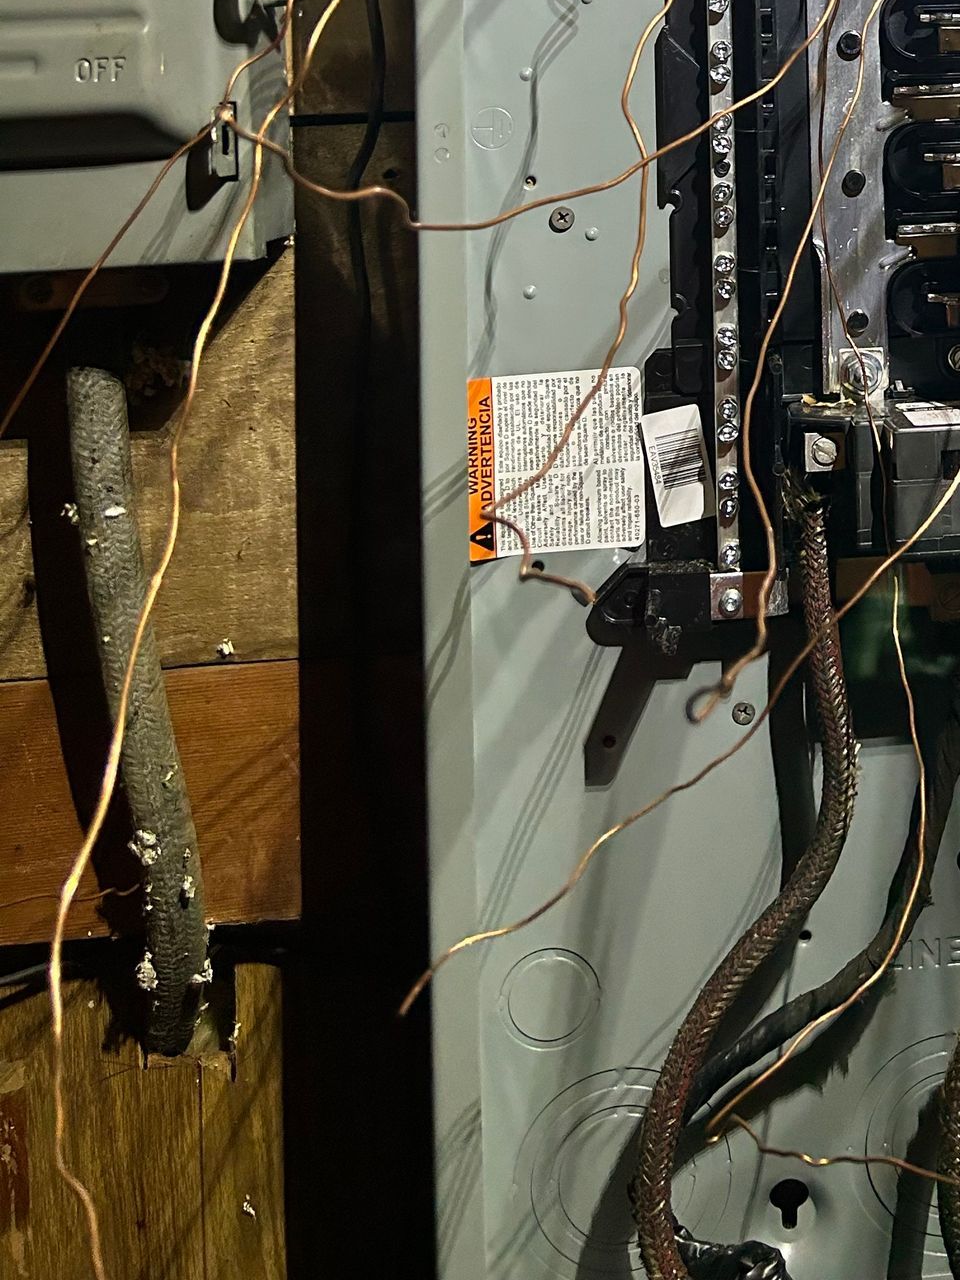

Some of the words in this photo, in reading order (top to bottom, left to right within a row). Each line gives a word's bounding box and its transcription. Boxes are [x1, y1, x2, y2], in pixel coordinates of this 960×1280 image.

[74, 56, 127, 83] OFF
[468, 417, 478, 495] WARNING
[479, 396, 491, 511] ADVERTENCIA
